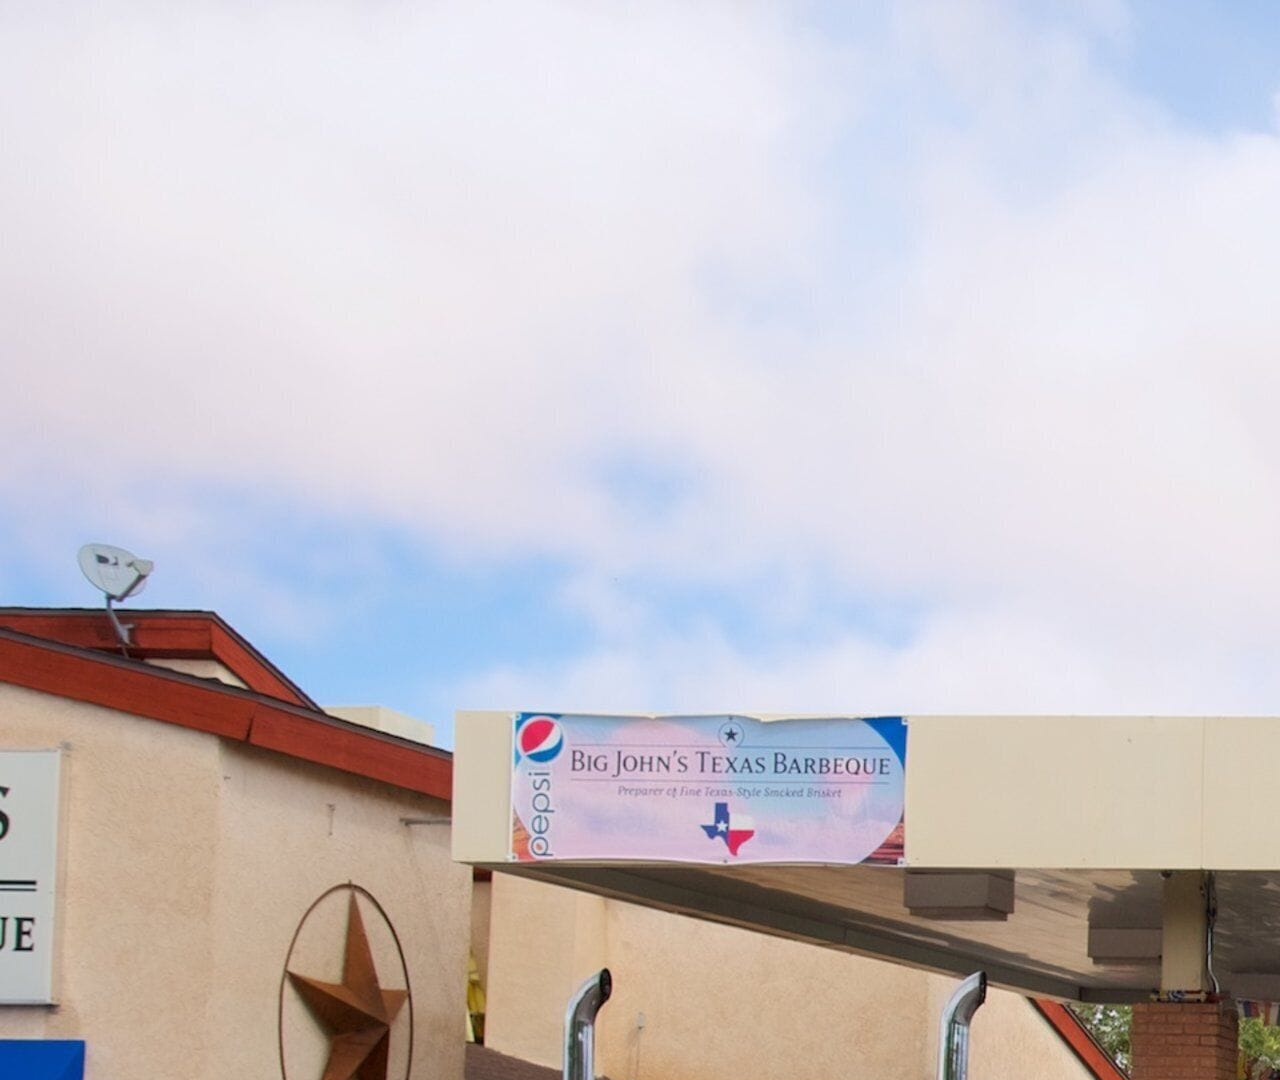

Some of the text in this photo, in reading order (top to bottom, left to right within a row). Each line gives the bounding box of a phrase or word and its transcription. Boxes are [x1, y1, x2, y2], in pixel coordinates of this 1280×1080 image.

[571, 750, 891, 778] BIG JOHN'S TEXAS BARBEQUE
[528, 771, 555, 857] pepsi
